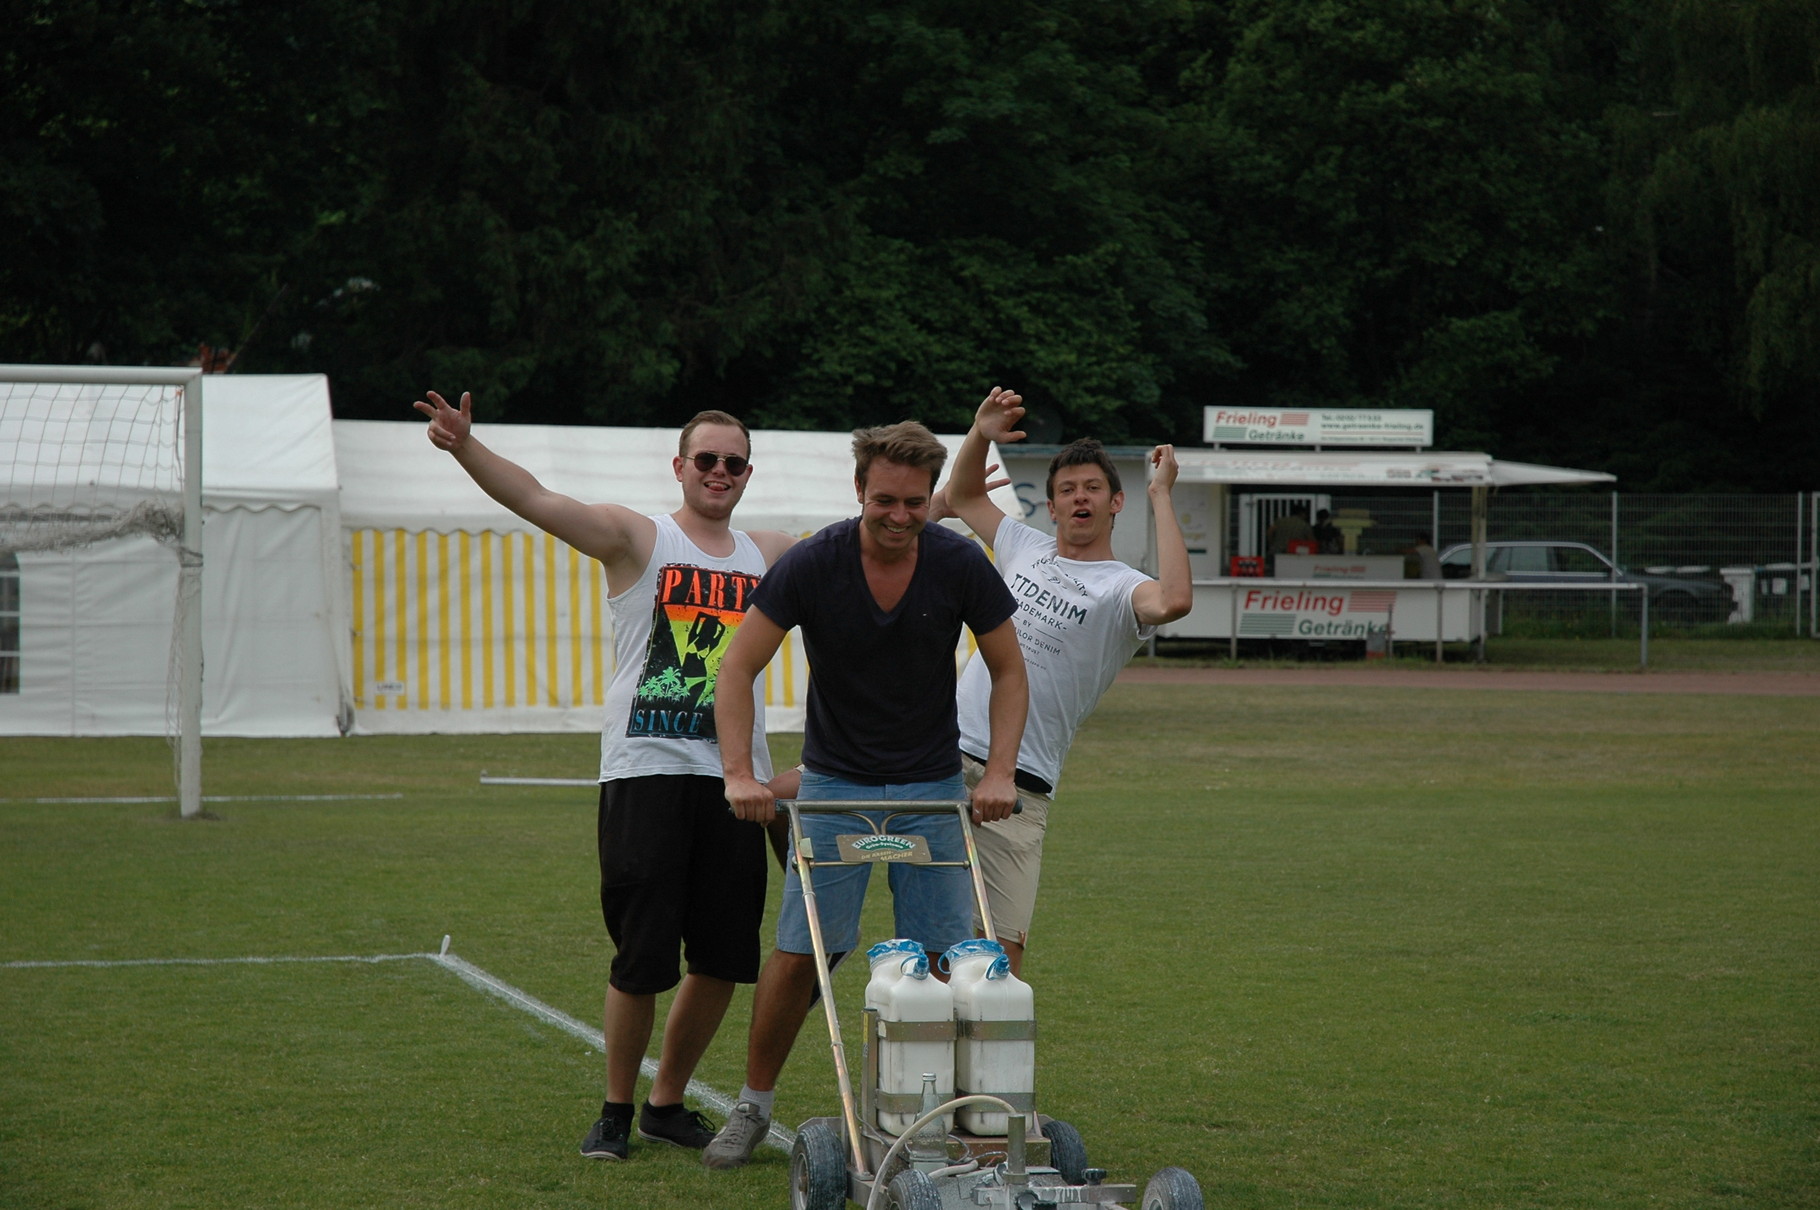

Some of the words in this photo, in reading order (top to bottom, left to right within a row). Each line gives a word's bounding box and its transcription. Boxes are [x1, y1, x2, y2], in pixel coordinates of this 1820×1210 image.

[1215, 411, 1277, 427] Frieling
[1248, 429, 1305, 441] Getränke
[1244, 590, 1345, 616] Frieling
[1022, 619, 1032, 628] BY
[1034, 638, 1061, 656] DENIM
[633, 708, 704, 734] SINCE
[852, 835, 916, 849] EUROGREEN
